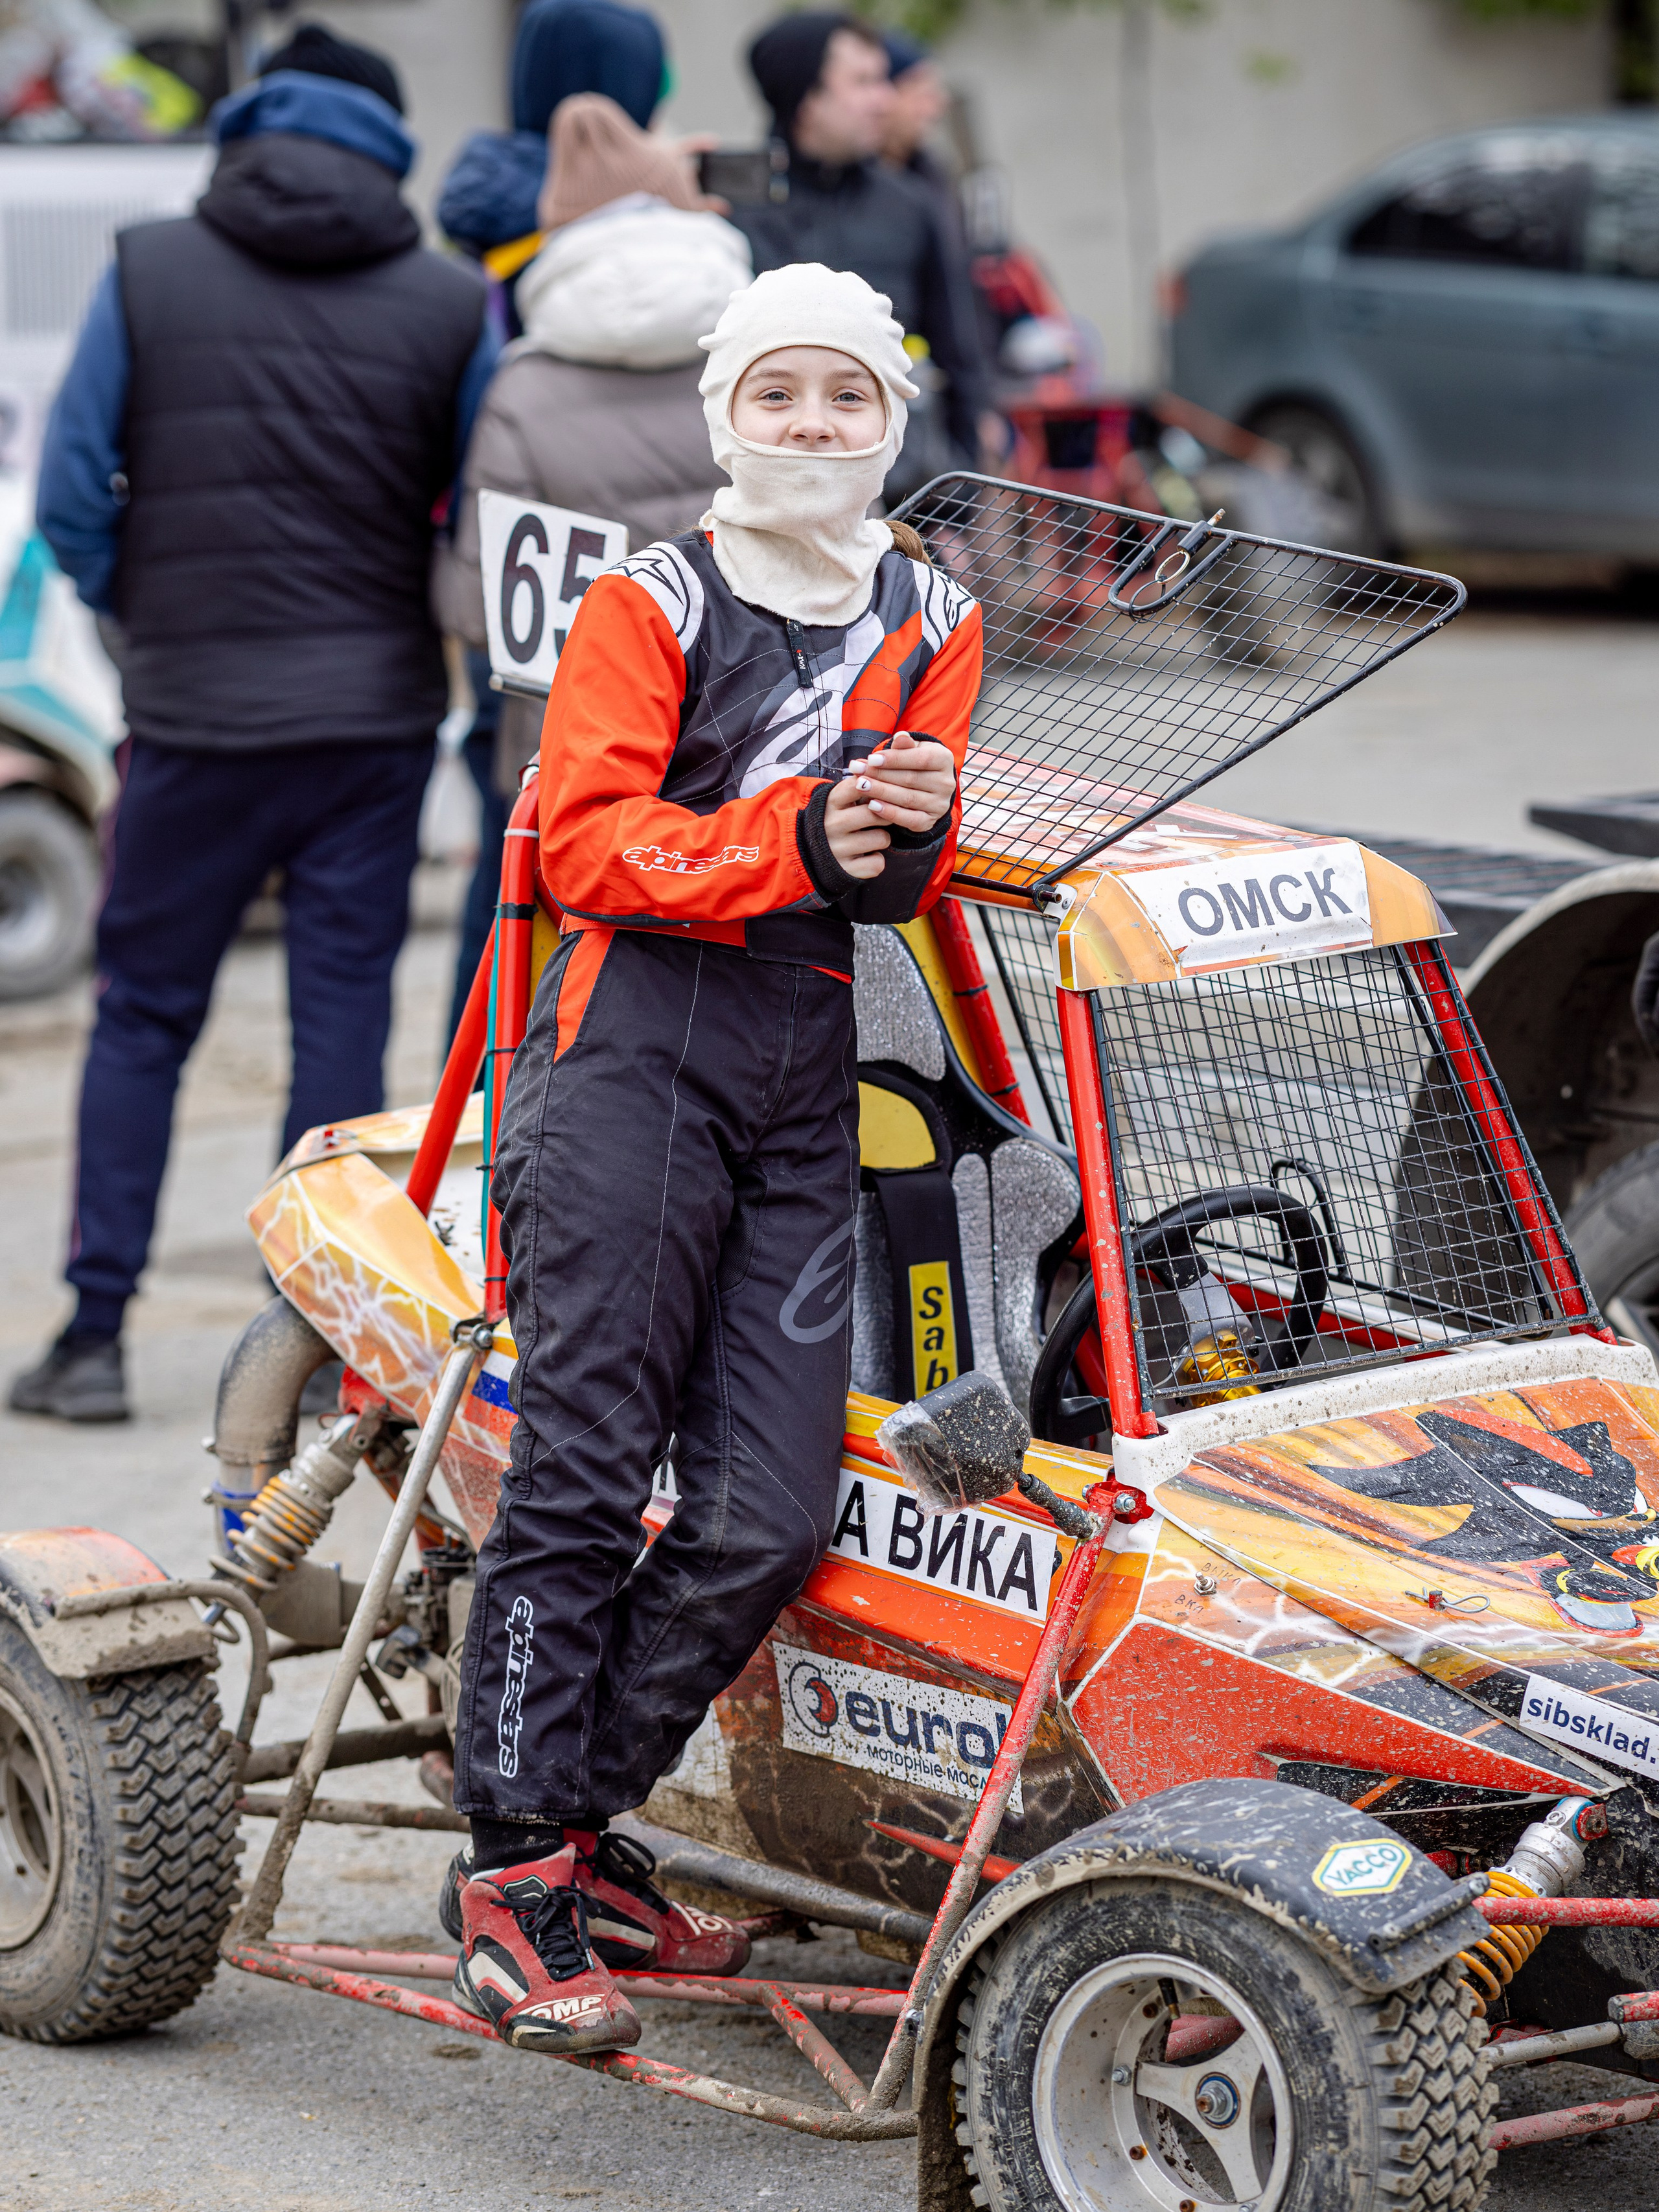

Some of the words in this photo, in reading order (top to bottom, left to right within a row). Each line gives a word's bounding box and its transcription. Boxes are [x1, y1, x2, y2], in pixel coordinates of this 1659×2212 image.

[501, 513, 607, 664] 65
[1178, 867, 1353, 937] ОМСК
[888, 1493, 1038, 1612] ВИКА
[498, 1595, 534, 1778] alpinestars
[866, 1743, 944, 1778] моторные
[1527, 1697, 1656, 1765] sibsklad.
[1327, 1847, 1398, 1885] YACCO
[531, 1996, 602, 2021] OMP
